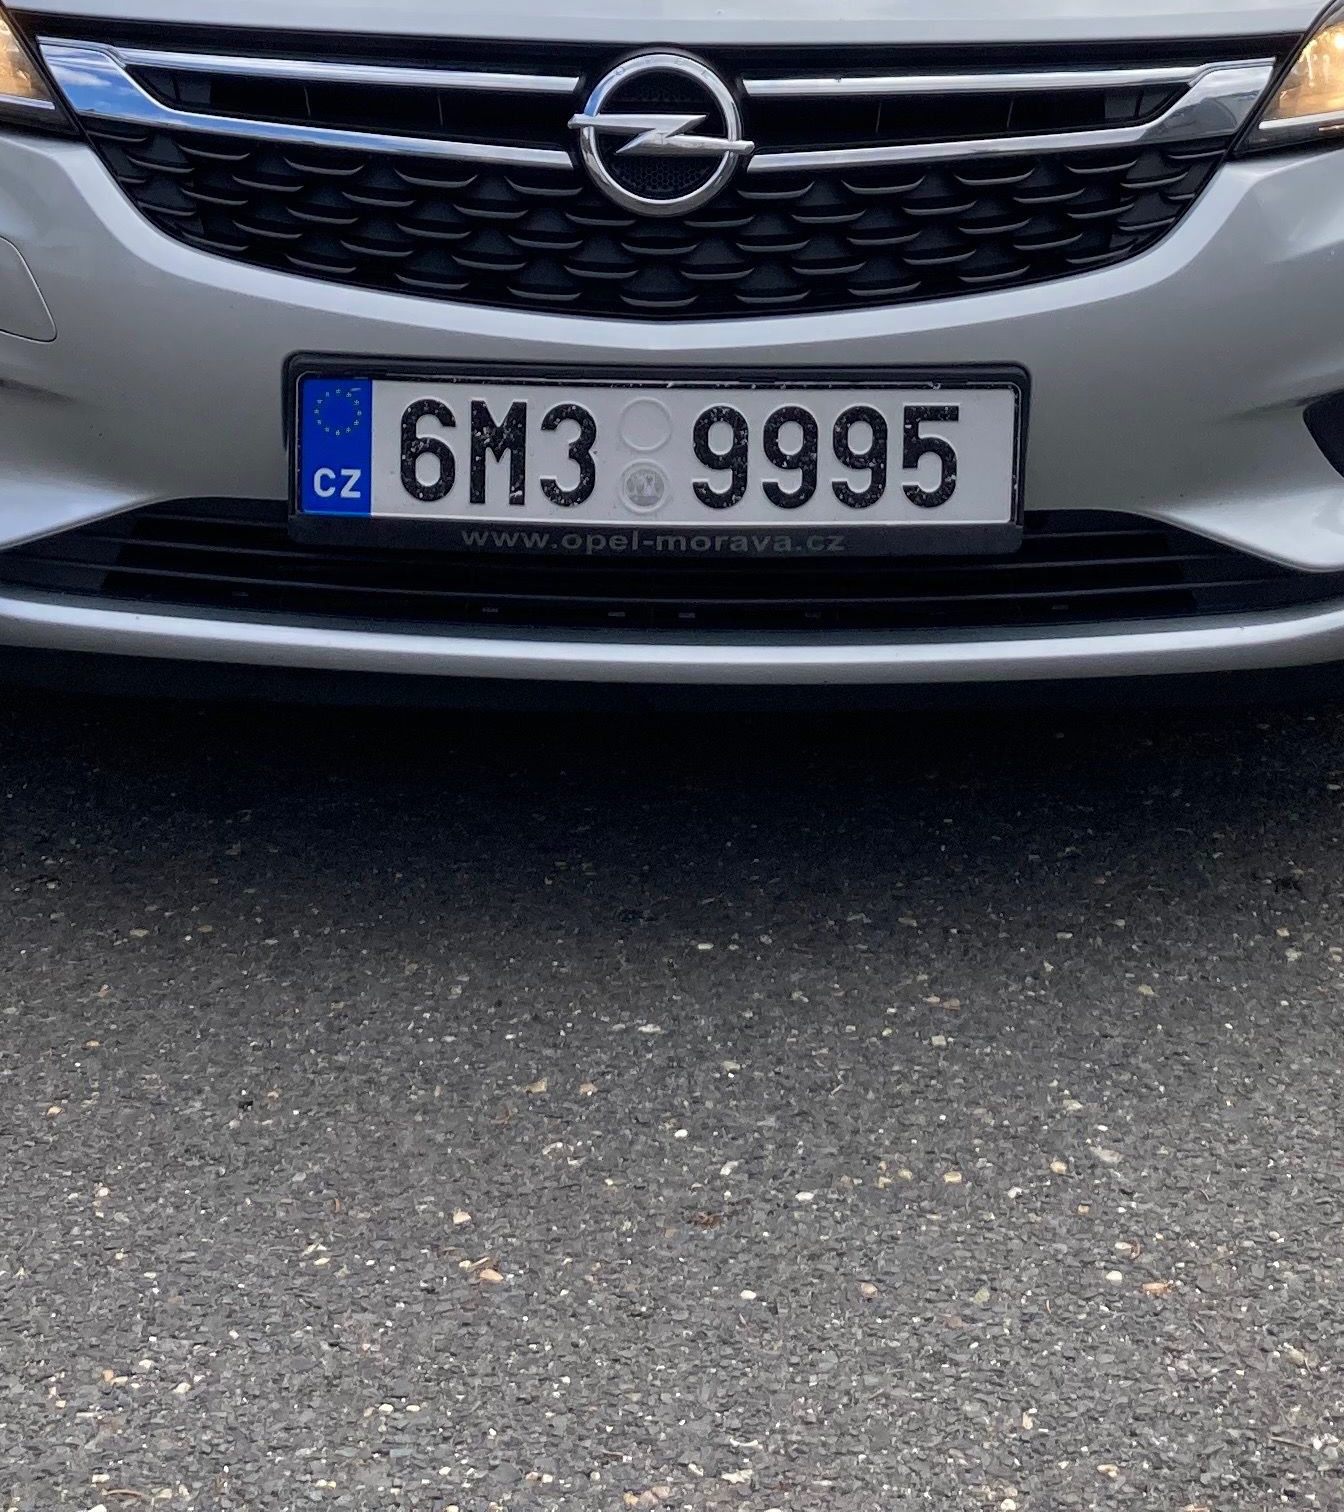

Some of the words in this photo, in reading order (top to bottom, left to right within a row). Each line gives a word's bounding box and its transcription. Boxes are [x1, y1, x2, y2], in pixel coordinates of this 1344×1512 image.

[400, 398, 598, 507] 6M3
[692, 405, 960, 509] 9995
[313, 467, 362, 499] CZ
[461, 529, 846, 554] www.opel-morava.cz
